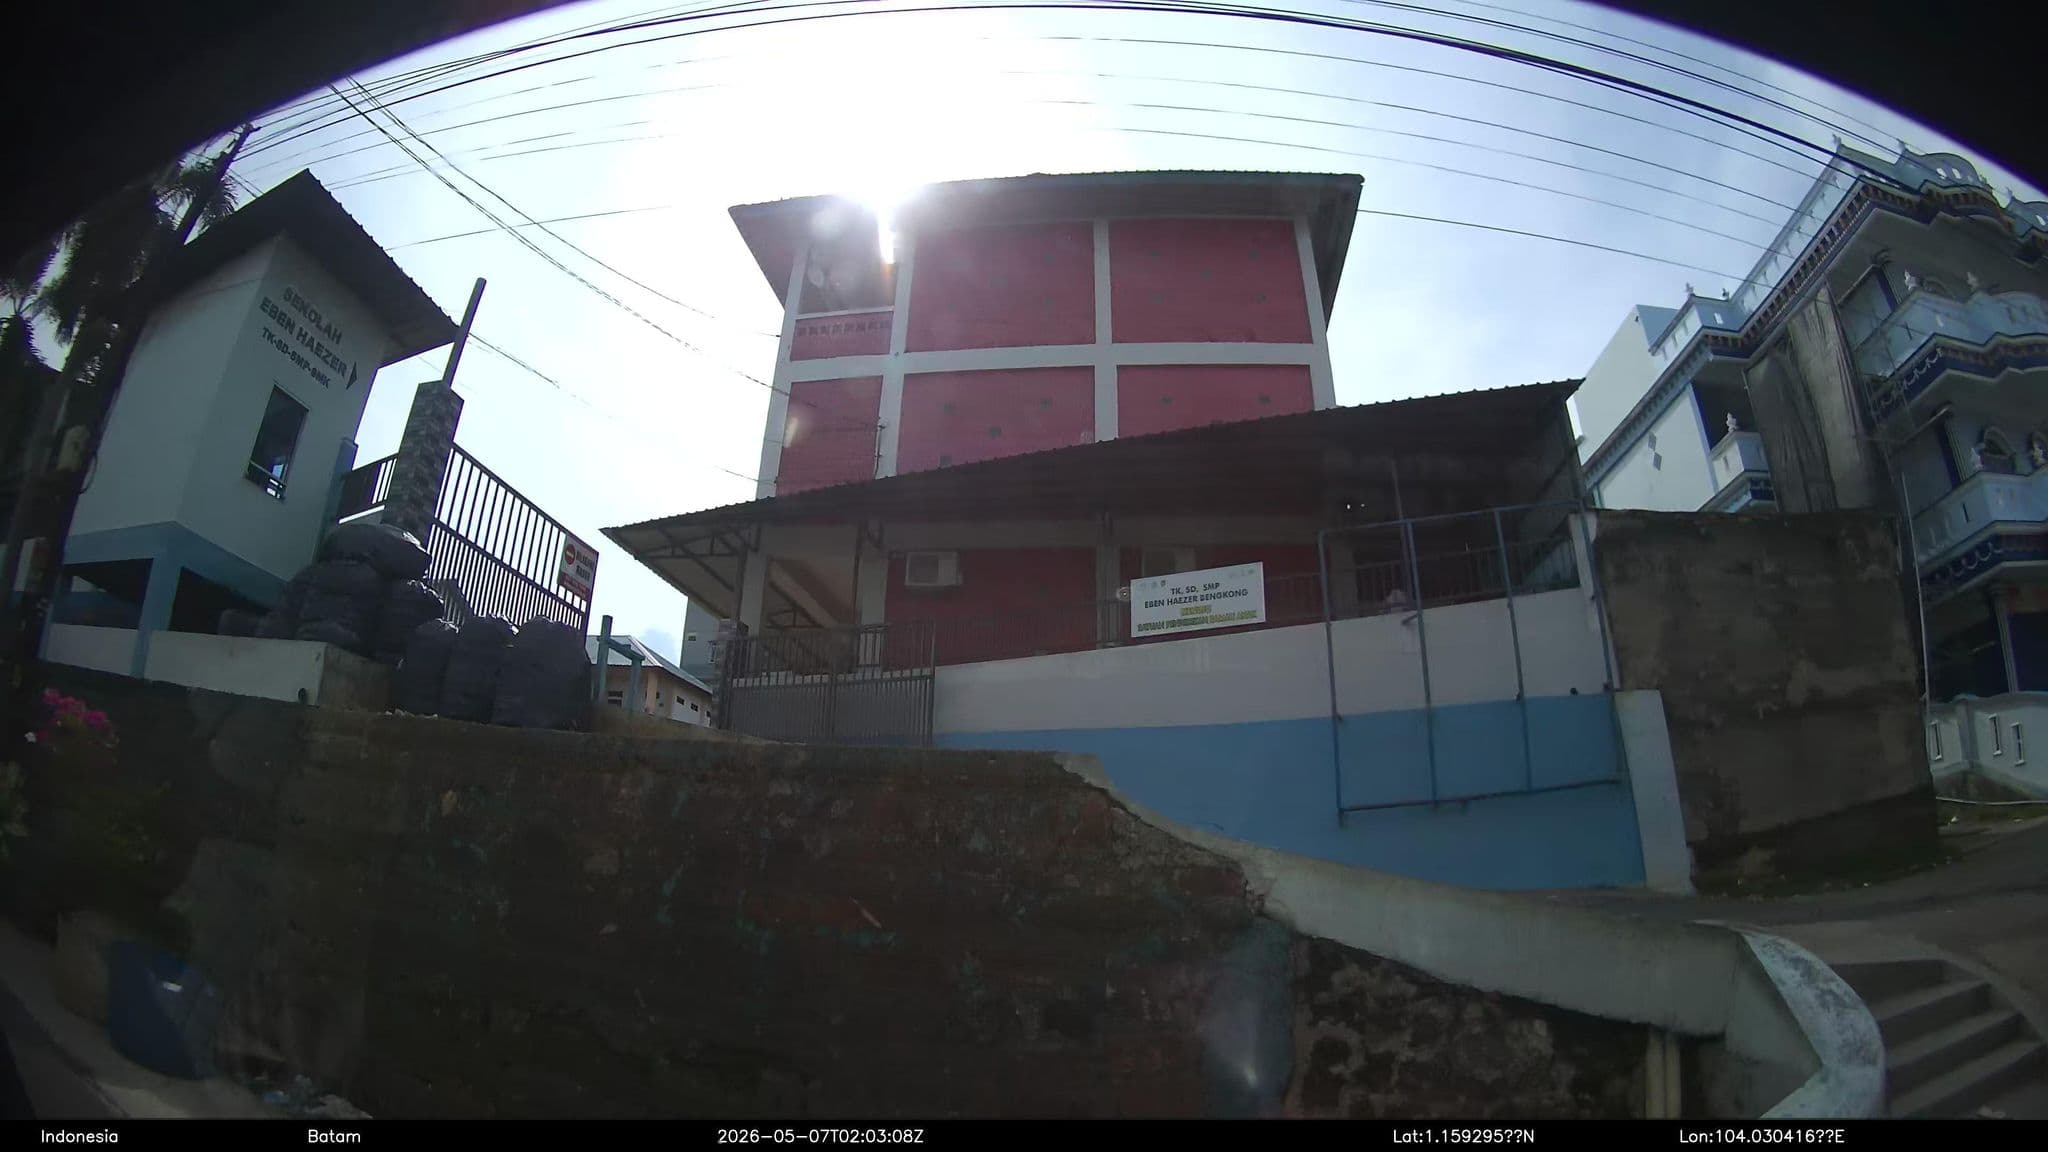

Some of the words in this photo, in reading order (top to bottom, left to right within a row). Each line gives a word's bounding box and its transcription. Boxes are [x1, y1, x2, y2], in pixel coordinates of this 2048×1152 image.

[283, 287, 342, 344] SEKOLAH
[260, 296, 296, 335] EBEN
[296, 326, 347, 378] HAEZER
[1144, 600, 1165, 609] EBEN
[1167, 594, 1198, 605] HAEZER
[1199, 588, 1249, 601] BENGKONG
[1203, 582, 1220, 591] SMP
